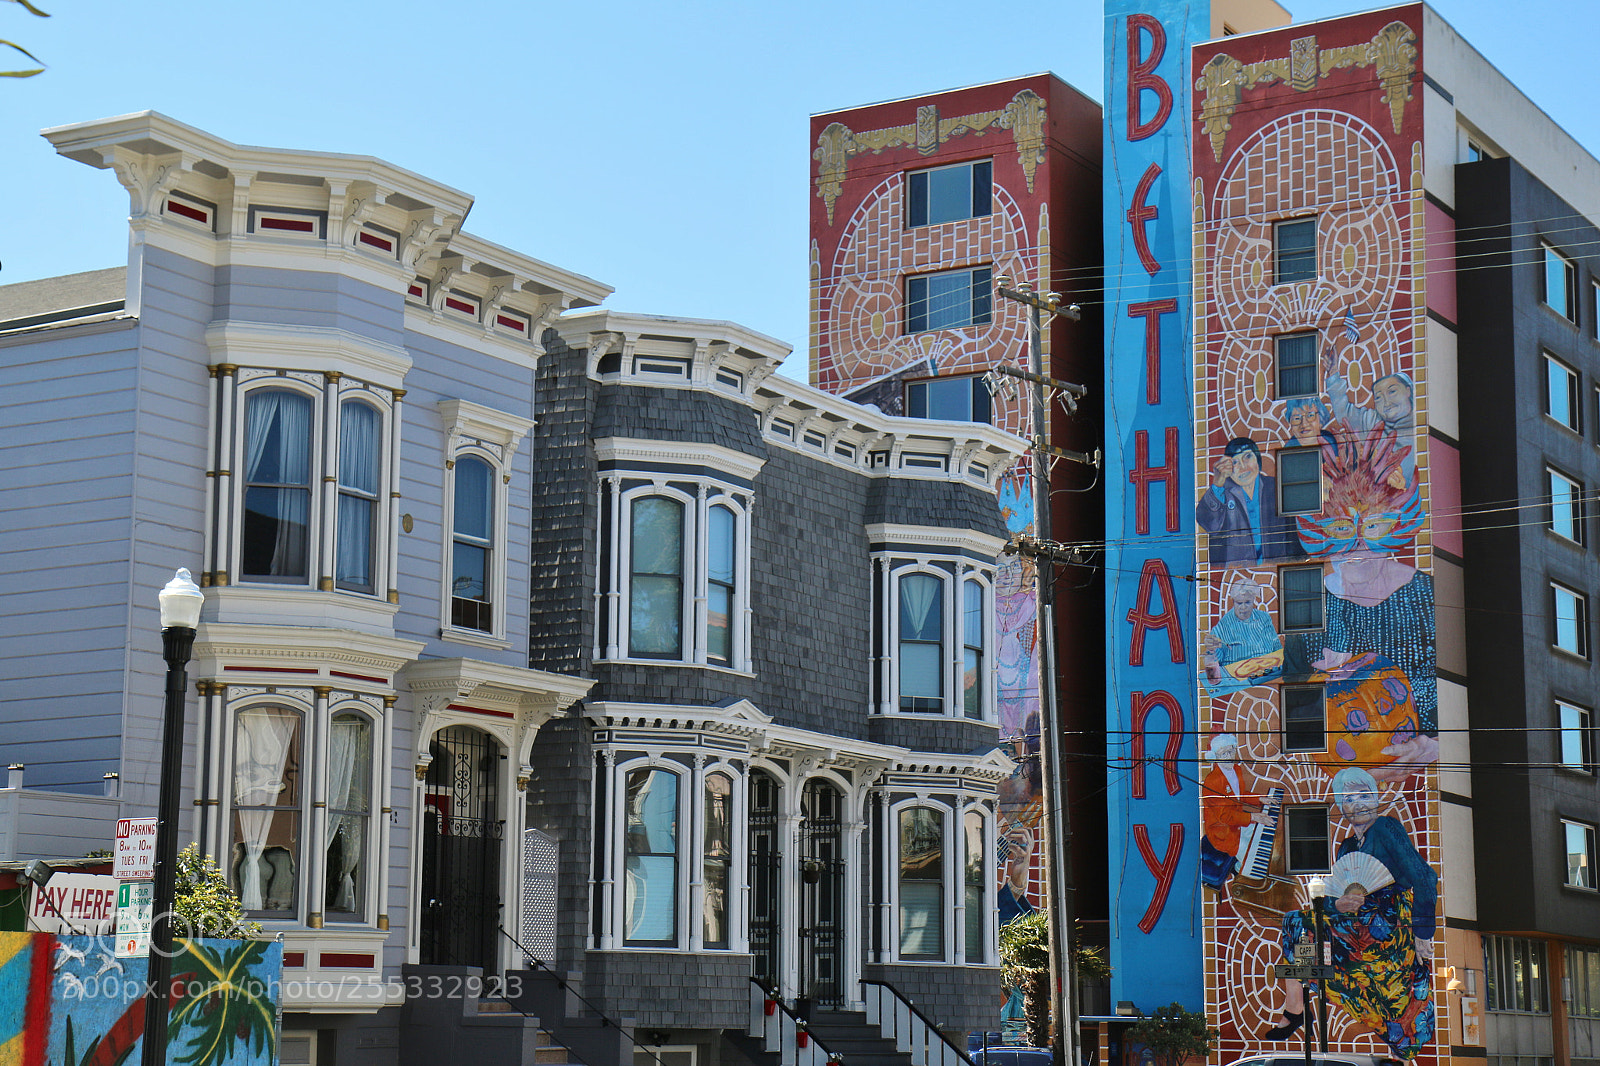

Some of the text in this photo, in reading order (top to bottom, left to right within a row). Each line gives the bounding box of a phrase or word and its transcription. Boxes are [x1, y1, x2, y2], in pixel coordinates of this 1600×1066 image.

[1126, 13, 1184, 934] BETHANY
[117, 821, 156, 837] NO PARKING
[121, 855, 135, 866] TUES
[122, 888, 149, 903] 1 HOUR
[131, 897, 152, 906] PARKING
[34, 886, 114, 920] PAY HERE
[141, 922, 151, 931] SAT
[1311, 968, 1325, 976] ST
